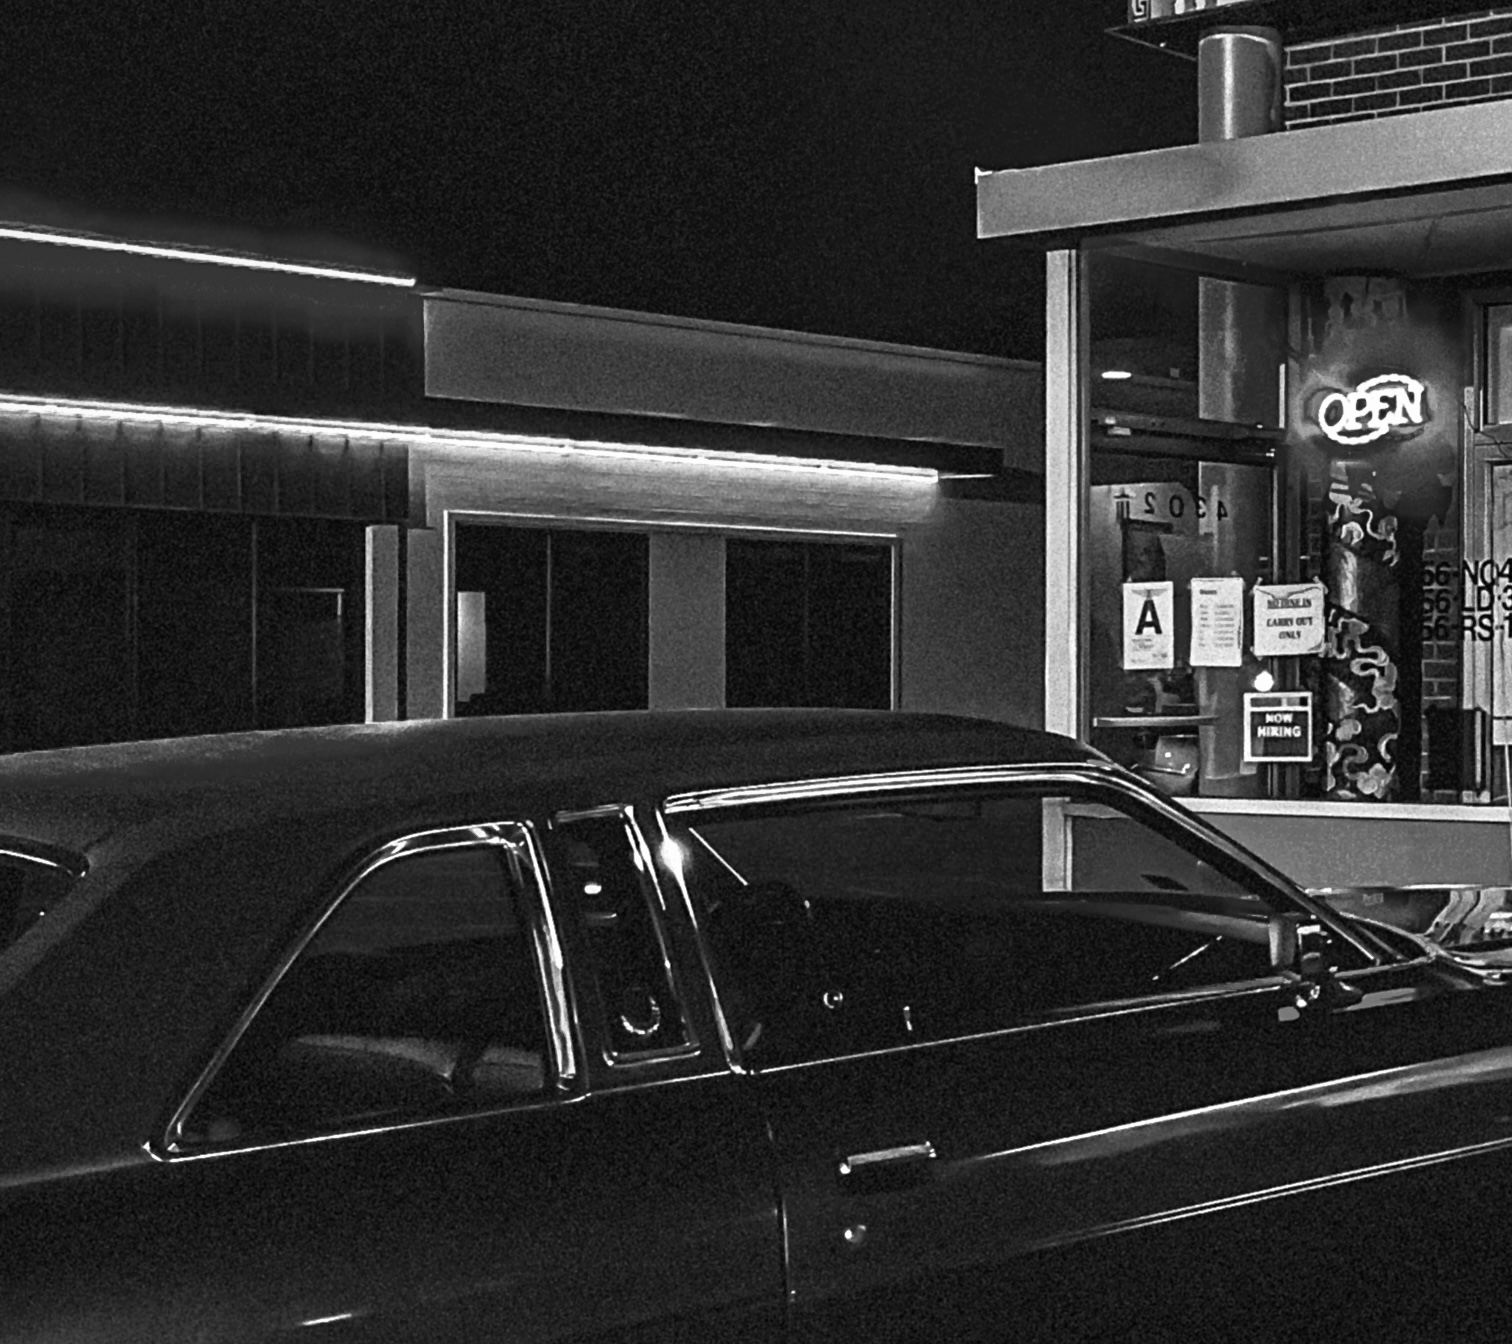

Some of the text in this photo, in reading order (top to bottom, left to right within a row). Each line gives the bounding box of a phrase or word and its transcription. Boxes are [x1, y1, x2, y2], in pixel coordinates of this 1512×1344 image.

[1319, 381, 1424, 440] OPEN
[1135, 599, 1163, 635] A
[1266, 617, 1313, 627] CARRY OUT
[1279, 630, 1302, 639] ONLY
[1265, 712, 1293, 723] NOW
[1257, 725, 1302, 737] HIRING
